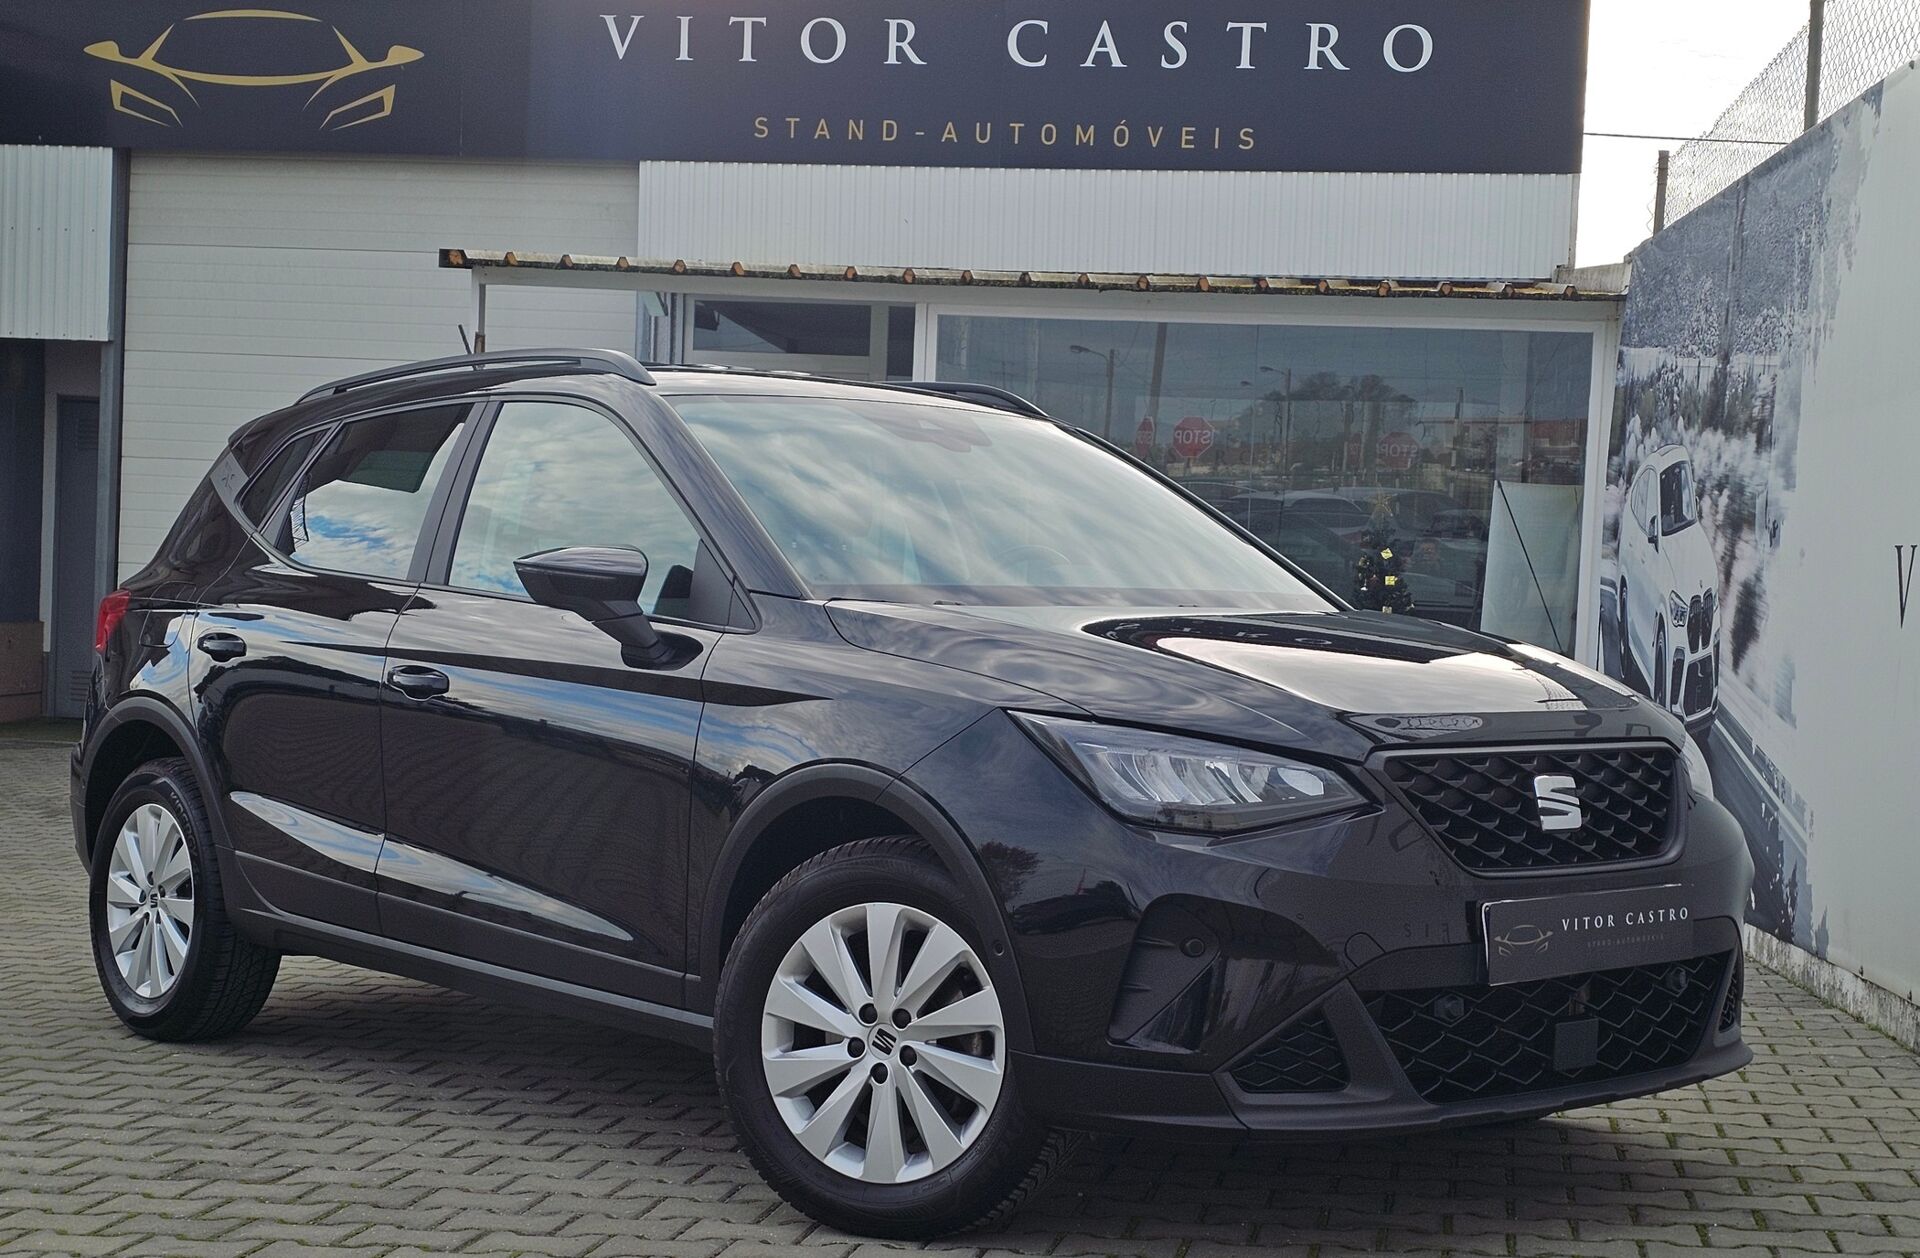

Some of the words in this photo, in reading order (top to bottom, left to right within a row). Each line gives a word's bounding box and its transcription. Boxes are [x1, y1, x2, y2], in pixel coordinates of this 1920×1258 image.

[599, 14, 928, 65] VITOR
[1007, 19, 1433, 73] CASTRO
[753, 116, 1256, 150] STAND-AUTOMÓVEIS
[1561, 914, 1615, 932] VITOR
[1625, 906, 1689, 926] CASTRO
